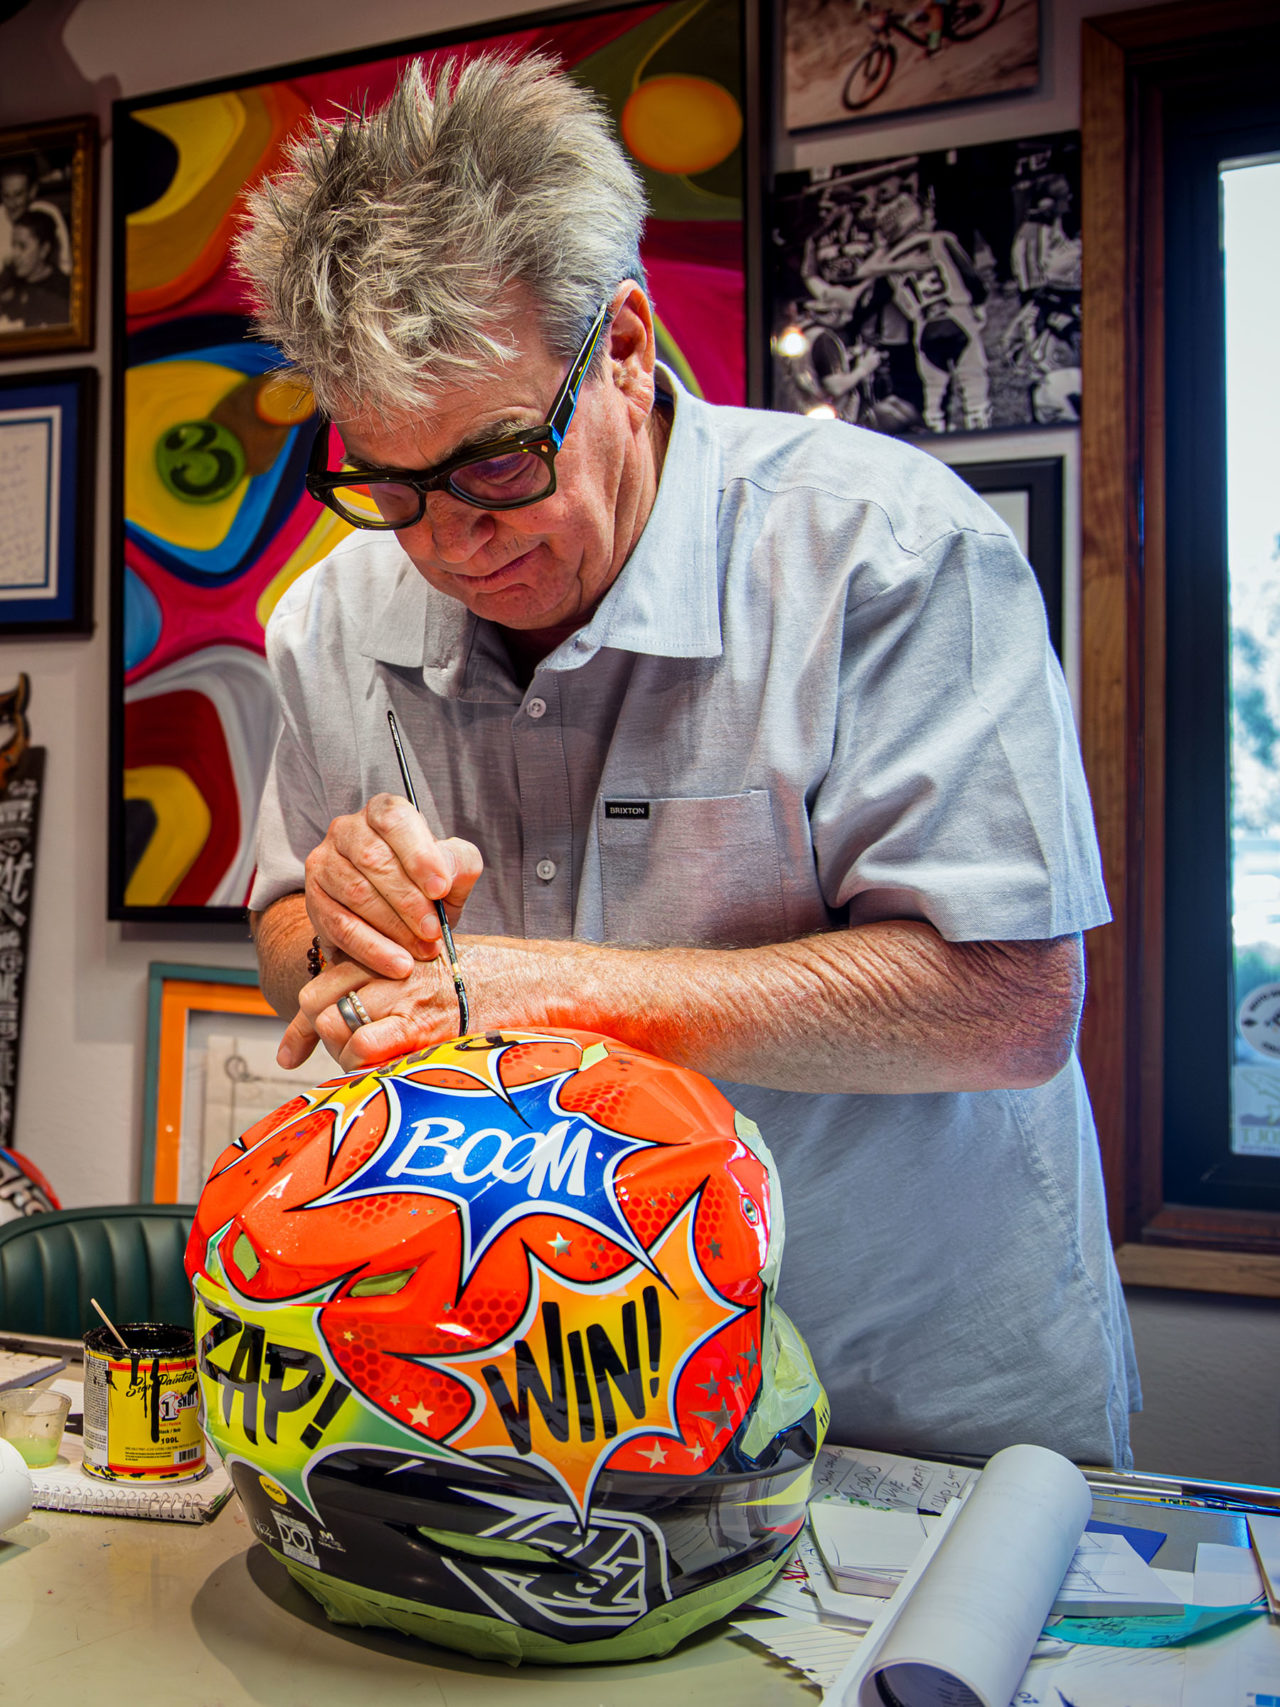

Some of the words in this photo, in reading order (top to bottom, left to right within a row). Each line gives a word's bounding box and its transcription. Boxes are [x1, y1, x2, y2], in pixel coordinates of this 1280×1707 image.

[165, 423, 235, 496] 3
[609, 807, 645, 815] BRIXTON
[386, 1115, 594, 1199] BOOM
[197, 1305, 354, 1448] ZAP!
[481, 1286, 664, 1456] WIN!
[277, 1522, 316, 1556] DOT
